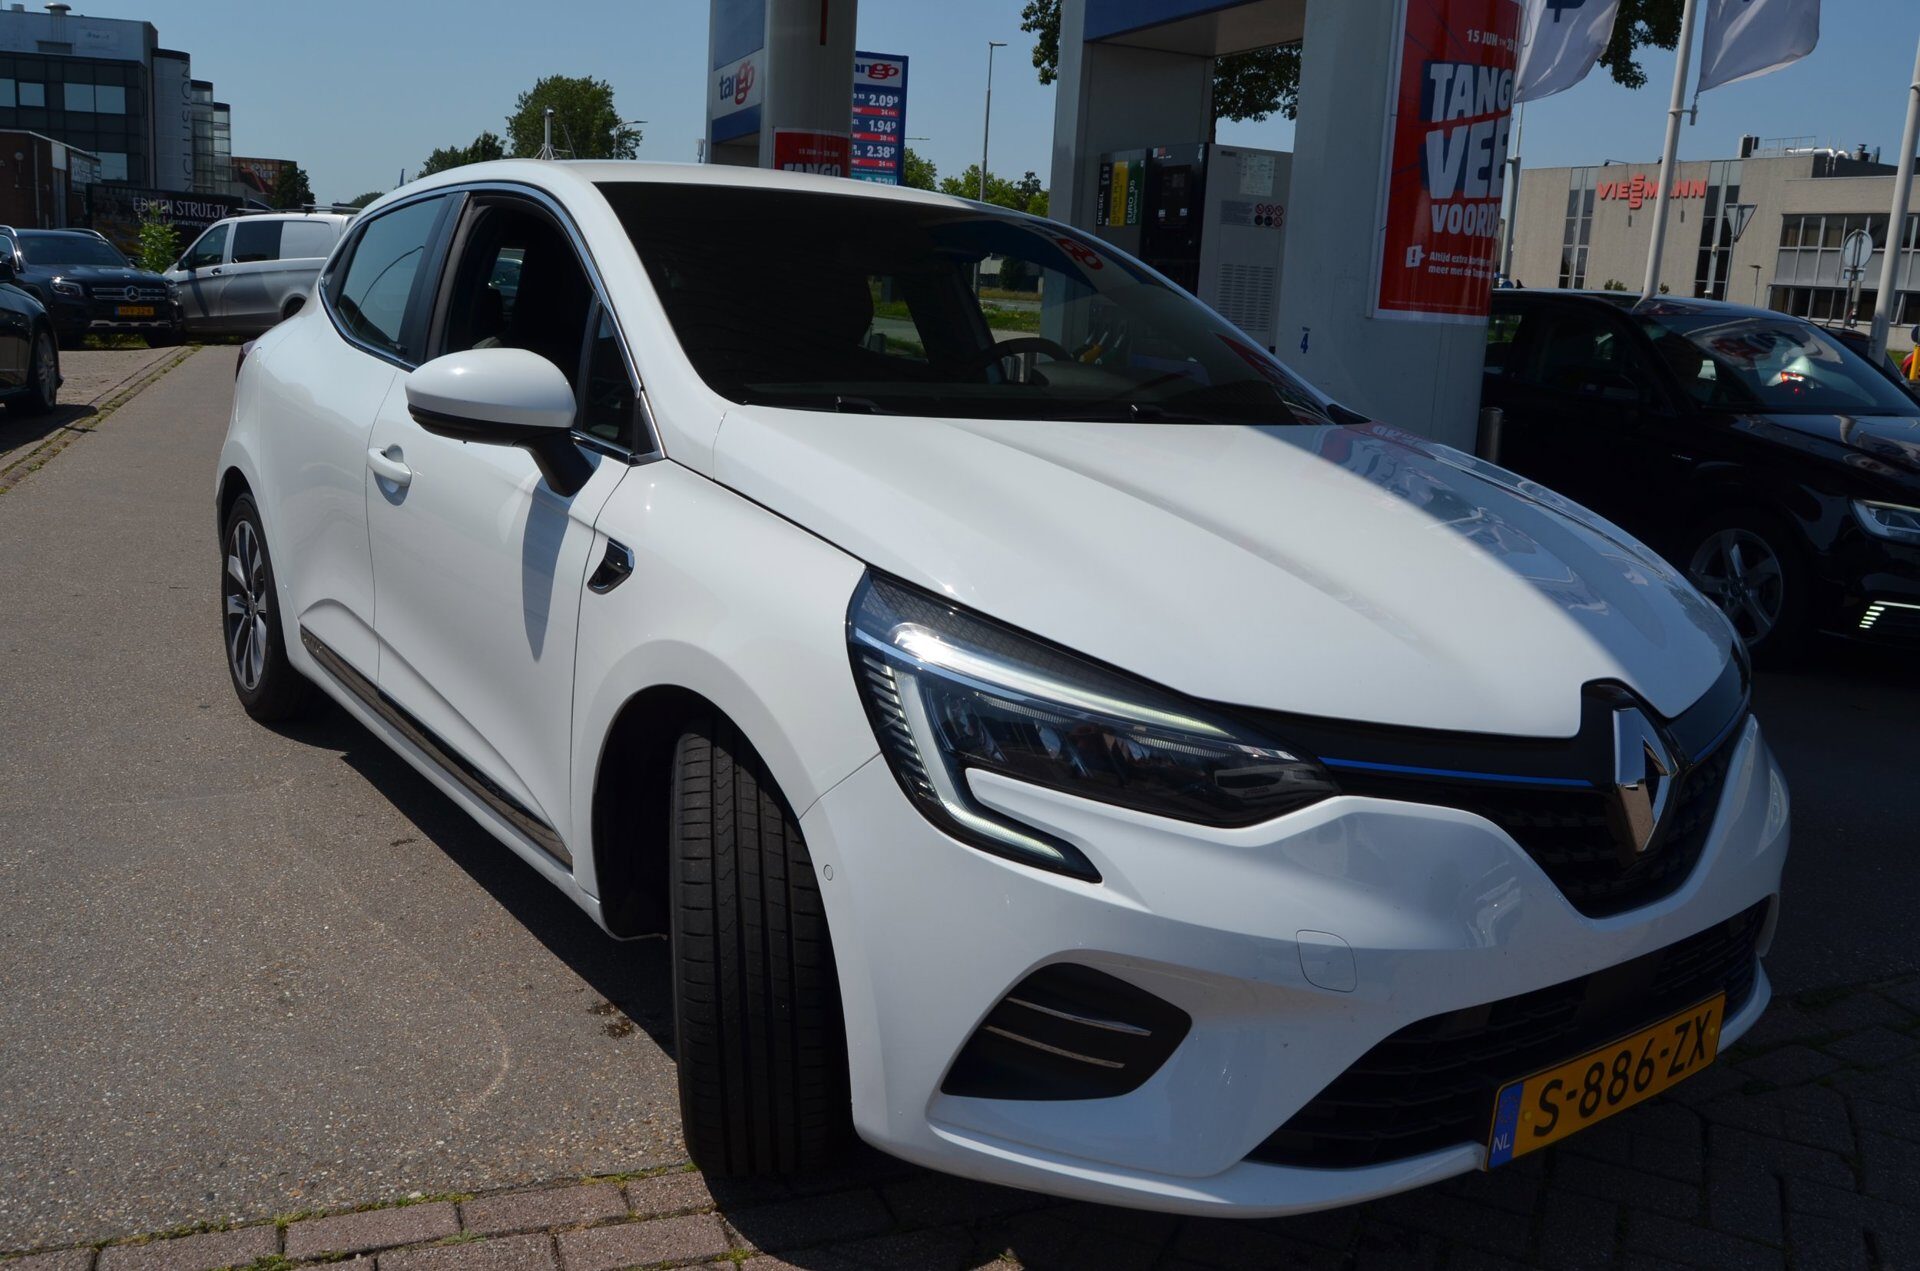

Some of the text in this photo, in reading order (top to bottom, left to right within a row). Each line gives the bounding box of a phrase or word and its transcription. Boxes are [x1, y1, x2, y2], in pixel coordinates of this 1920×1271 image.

[1466, 28, 1480, 44] 15
[719, 62, 755, 105] tango
[1430, 63, 1512, 123] TANG
[1096, 191, 1105, 225] DIESEL
[1597, 173, 1707, 209] VIESSMNN
[1300, 333, 1309, 354] 4
[1533, 1009, 1713, 1138] S-886-ZX
[1493, 1132, 1511, 1153] NL
